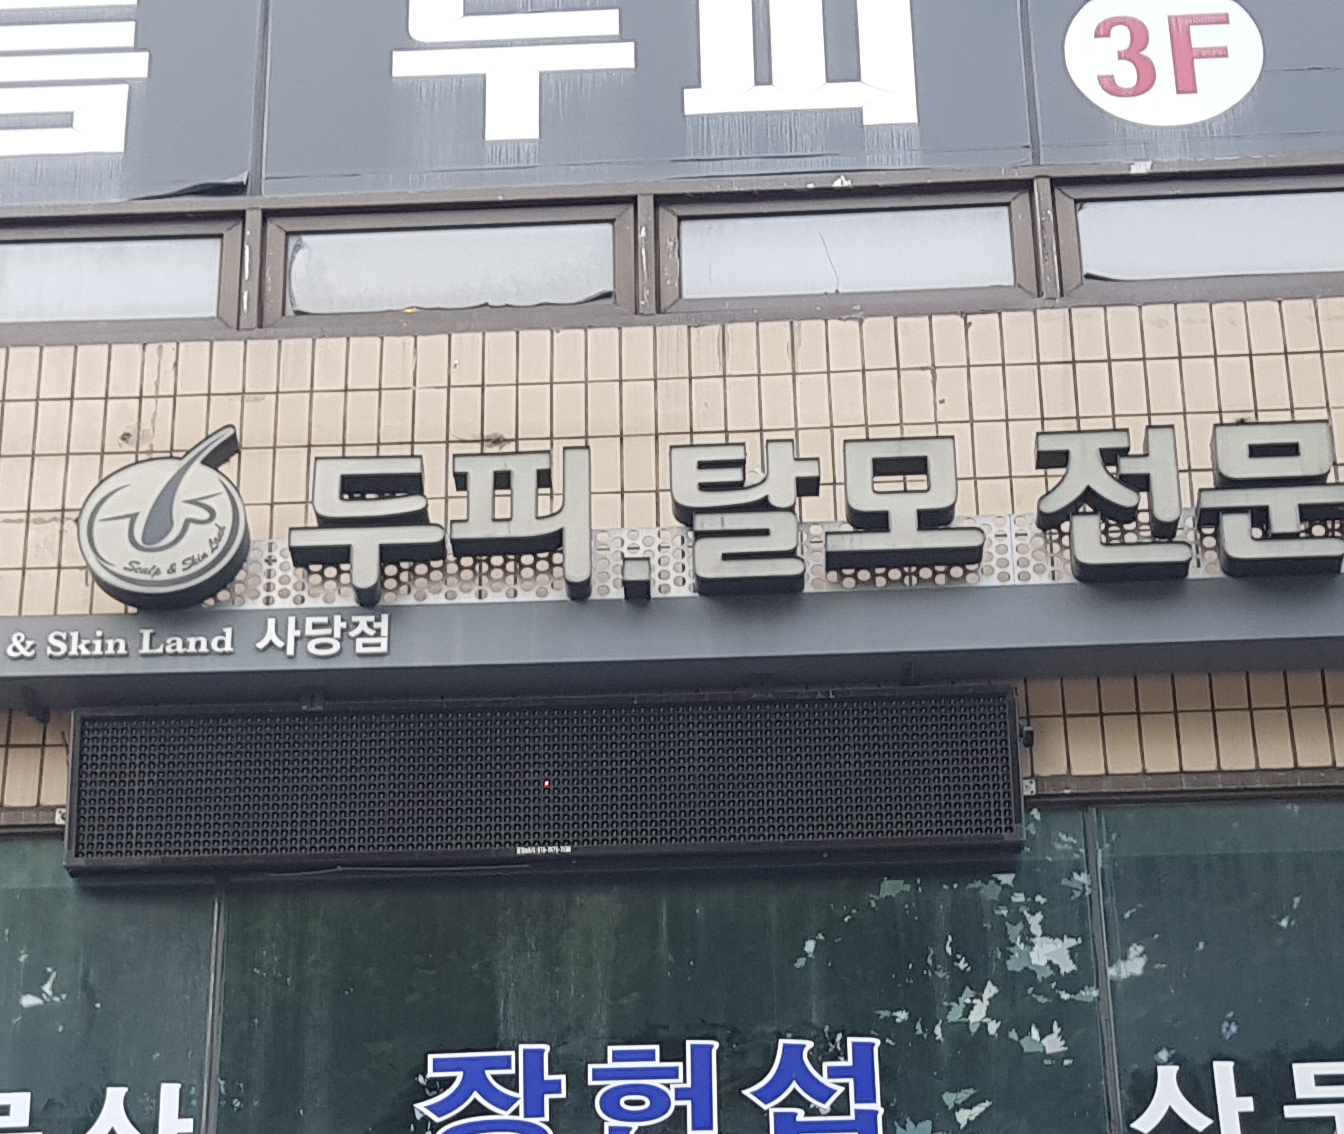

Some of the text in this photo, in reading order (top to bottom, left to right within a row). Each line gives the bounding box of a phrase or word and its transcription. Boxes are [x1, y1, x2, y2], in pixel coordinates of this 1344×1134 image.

[391, 0, 918, 141] 두피
[1093, 12, 1229, 97] 3F
[123, 522, 227, 578] Scalp & Skin Land
[6, 635, 36, 660] &
[46, 629, 128, 659] Skin
[138, 626, 234, 656] Land
[255, 613, 391, 658] 사당점
